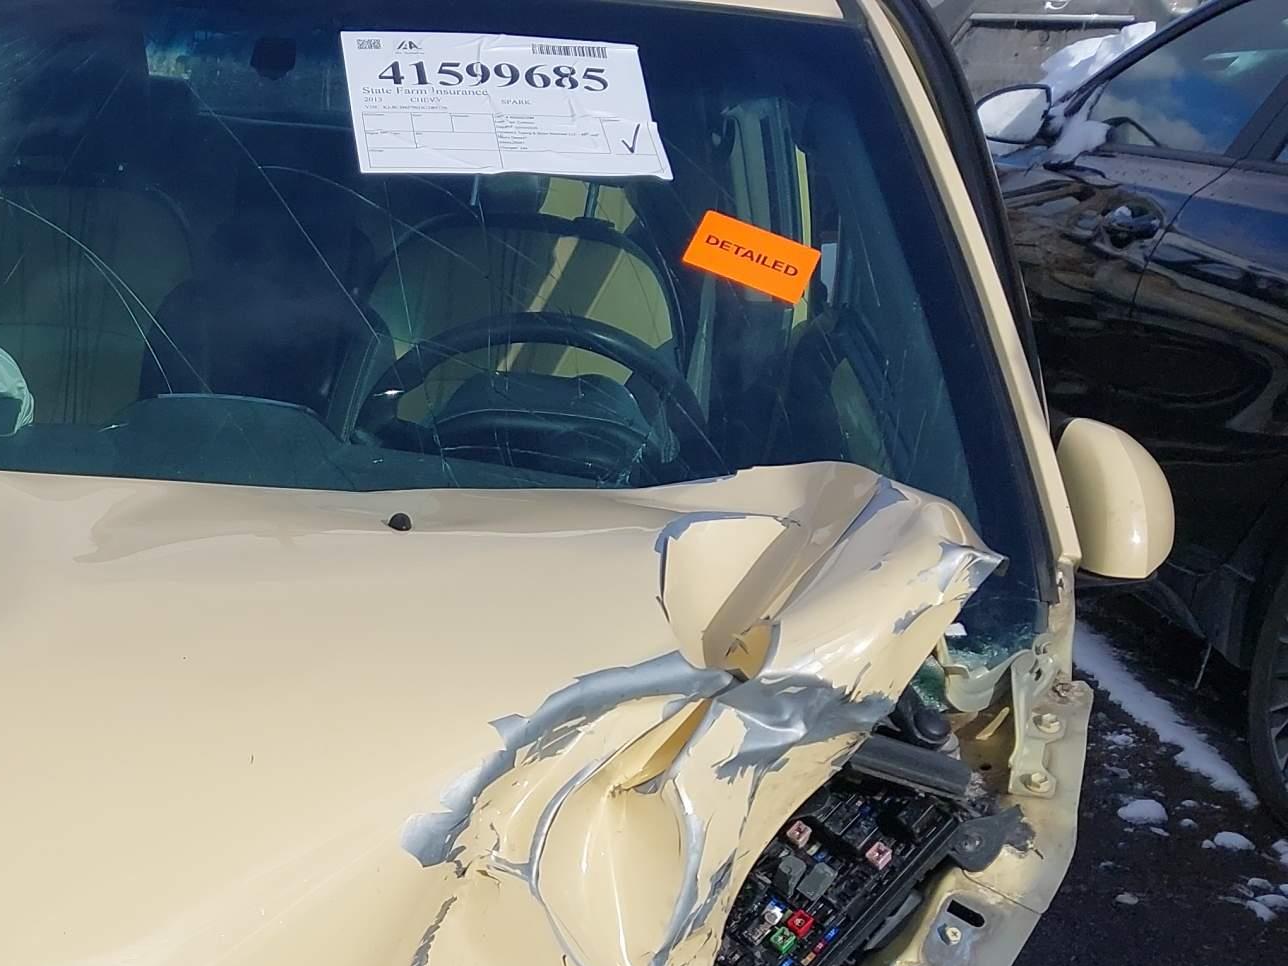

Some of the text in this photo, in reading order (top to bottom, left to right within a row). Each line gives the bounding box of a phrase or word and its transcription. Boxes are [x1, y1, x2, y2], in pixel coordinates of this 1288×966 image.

[362, 86, 489, 96] State Farm Insurance
[378, 60, 609, 92] 41599685
[705, 234, 799, 277] DETAILED
